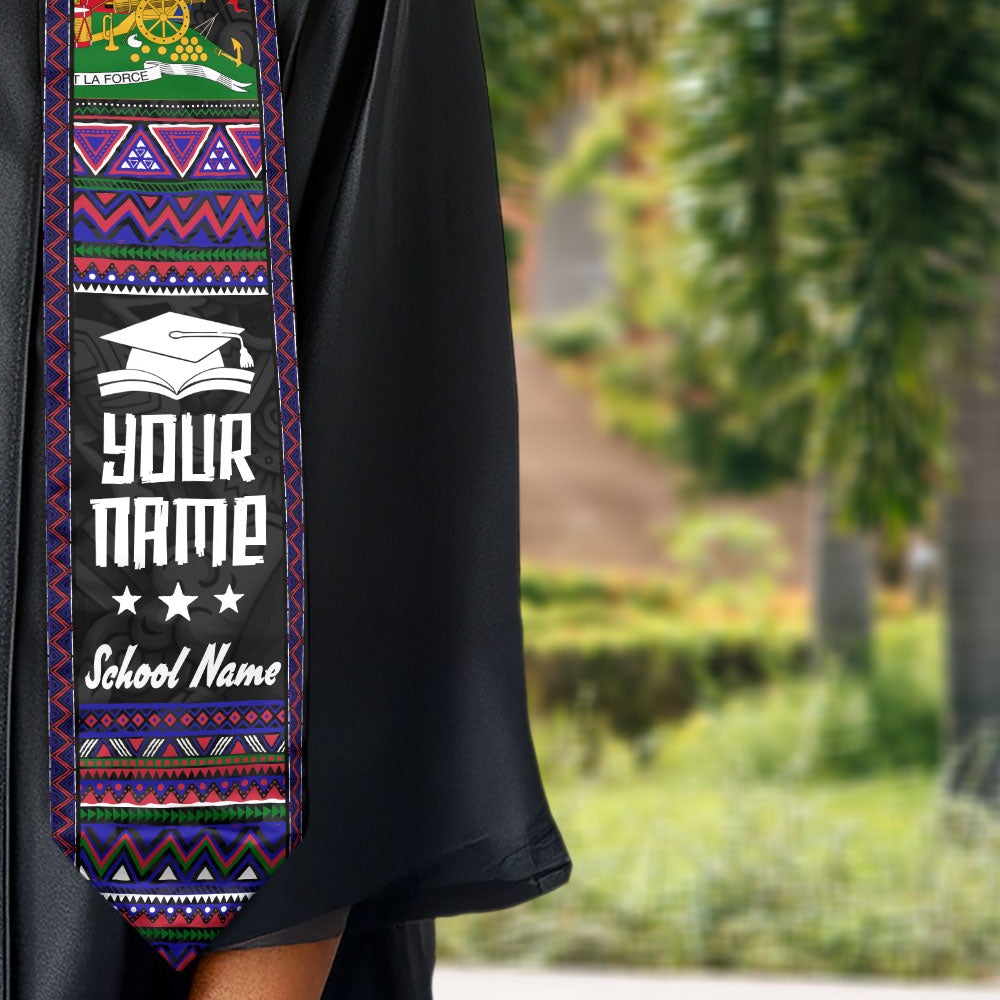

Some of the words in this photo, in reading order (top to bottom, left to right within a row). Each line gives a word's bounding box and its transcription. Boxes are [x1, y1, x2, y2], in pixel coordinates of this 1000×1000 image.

[84, 74, 100, 84] LA
[104, 70, 149, 84] FORCE
[101, 411, 256, 485] YOUR
[89, 494, 267, 570] NAME
[84, 643, 192, 690] School
[189, 641, 282, 688] Name
